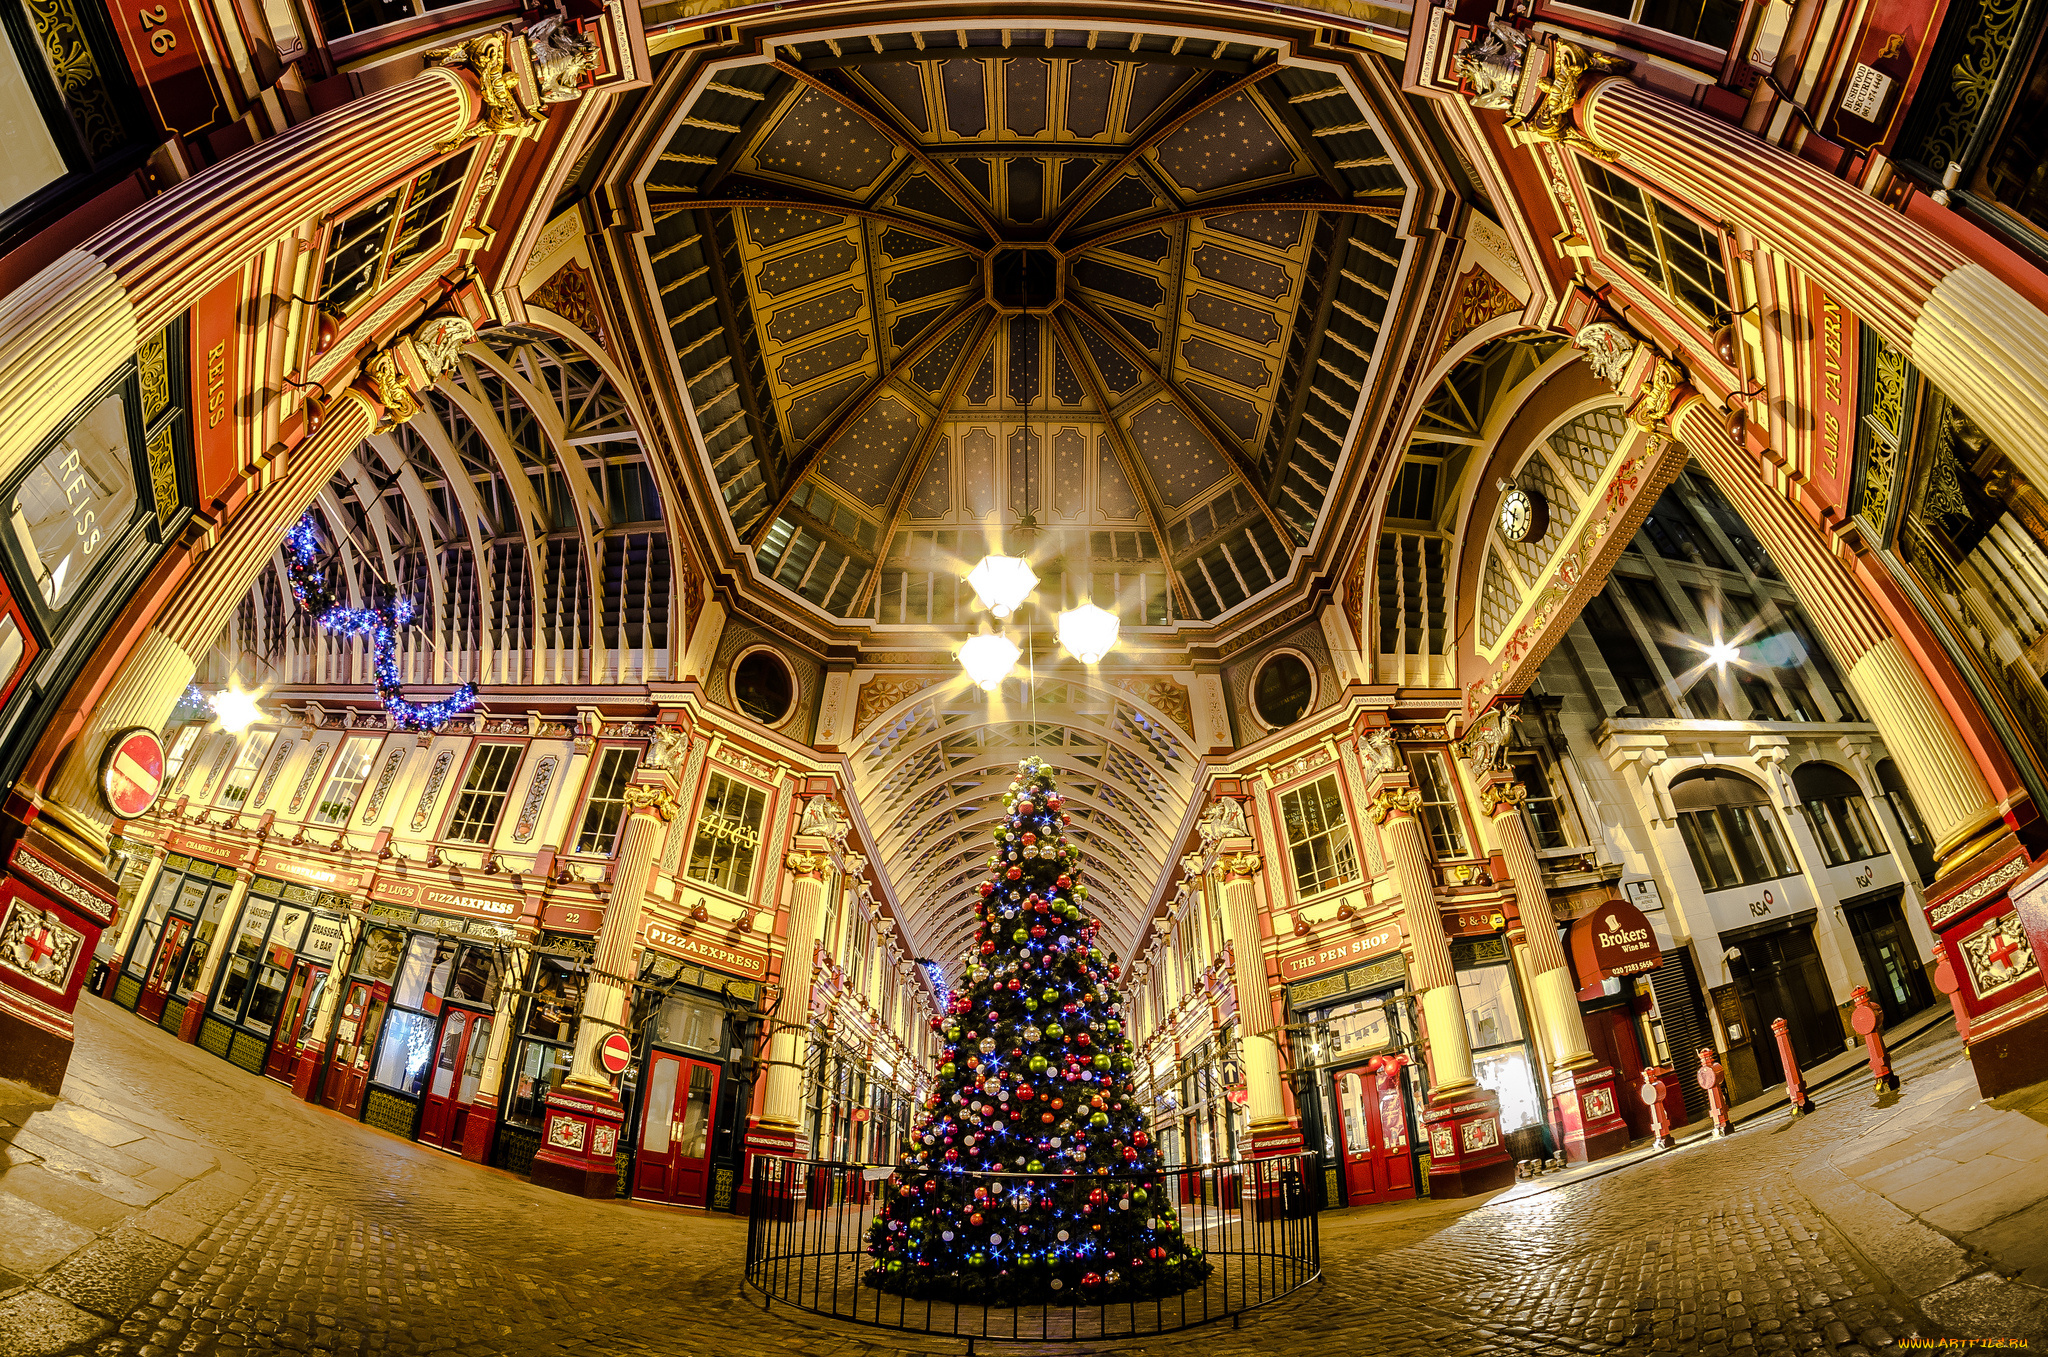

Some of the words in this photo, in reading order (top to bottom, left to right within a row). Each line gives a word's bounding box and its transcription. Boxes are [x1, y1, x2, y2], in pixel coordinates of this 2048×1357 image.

[140, 4, 177, 56] 26
[1844, 66, 1867, 109] BUSHWOOD
[1853, 69, 1875, 113] SECURITY
[1823, 293, 1842, 406] TAVERN
[208, 339, 225, 429] REISS
[1823, 411, 1841, 480] LAMB
[58, 448, 101, 555] REISS
[701, 813, 759, 849] LUC'S
[185, 840, 231, 858] CHAMBERLAIN'S
[275, 862, 337, 883] CHAMBERLAIN'S
[1855, 875, 1873, 889] RSA
[376, 883, 388, 893] 22
[388, 884, 415, 898] LUC'S
[427, 891, 515, 915] PIZZAEXPRESS
[1555, 899, 1584, 912] WINE
[1749, 901, 1771, 917] RSA
[565, 912, 580, 924] 22
[1458, 917, 1467, 928] 8
[1469, 916, 1479, 927] &
[1481, 915, 1489, 925] 9
[319, 941, 333, 953] BAR
[1598, 928, 1648, 948] Brokers
[1621, 944, 1640, 953] Wine
[1638, 941, 1650, 950] Bar
[650, 928, 761, 971] PIZZAEXPRESS
[1290, 955, 1316, 971] THE
[1319, 946, 1348, 963] PEN
[1352, 933, 1390, 954] SHOP
[1612, 966, 1624, 975] 020
[1623, 963, 1639, 973] 7283
[1639, 960, 1654, 970] 5656
